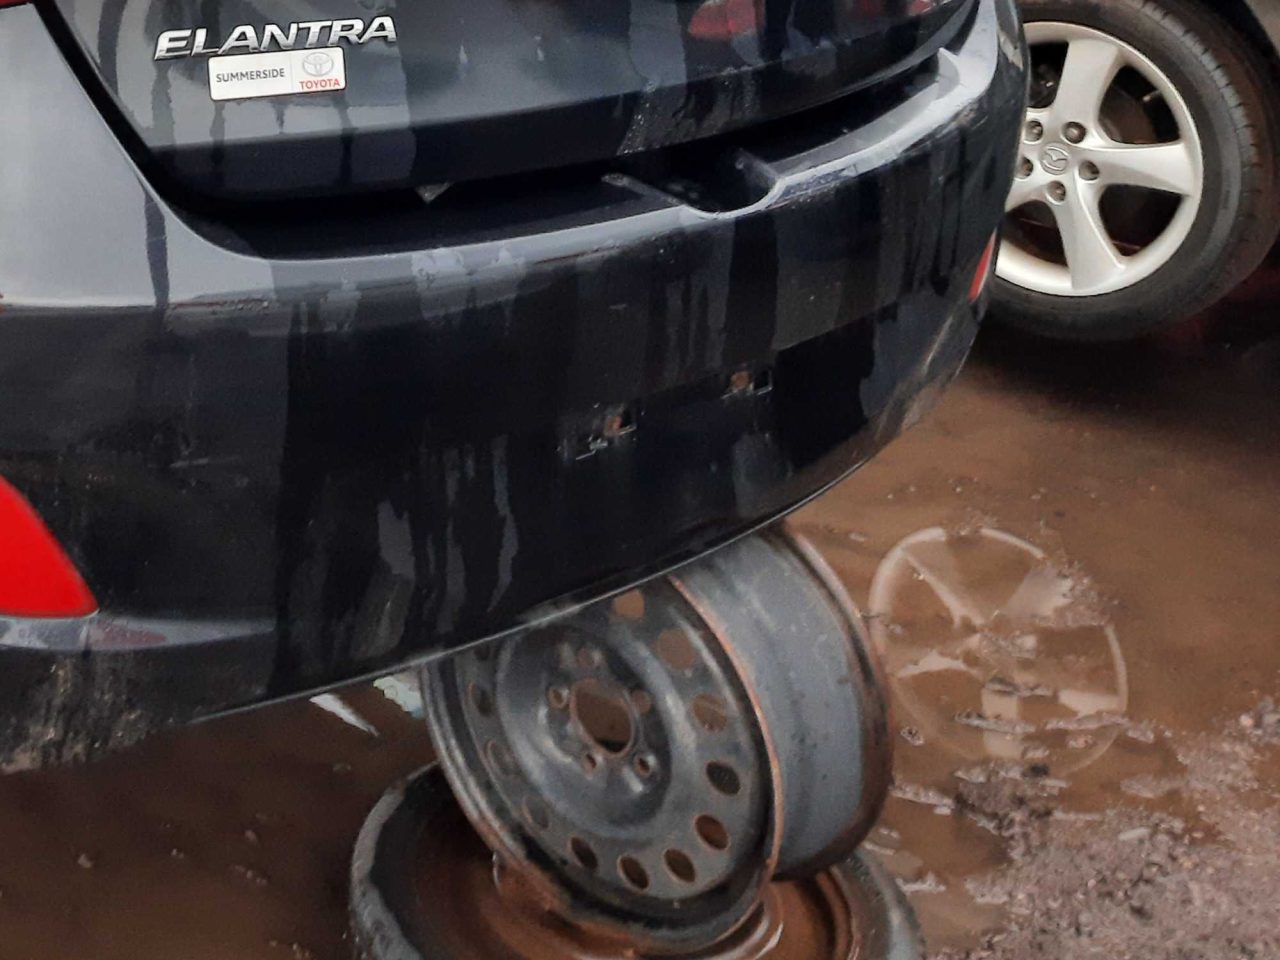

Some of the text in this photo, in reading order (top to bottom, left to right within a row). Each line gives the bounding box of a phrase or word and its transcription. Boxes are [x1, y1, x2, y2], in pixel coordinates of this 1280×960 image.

[154, 15, 398, 61] ELANTRA
[215, 67, 286, 84] SUMMERSIDE
[299, 77, 341, 91] TOYOTA
